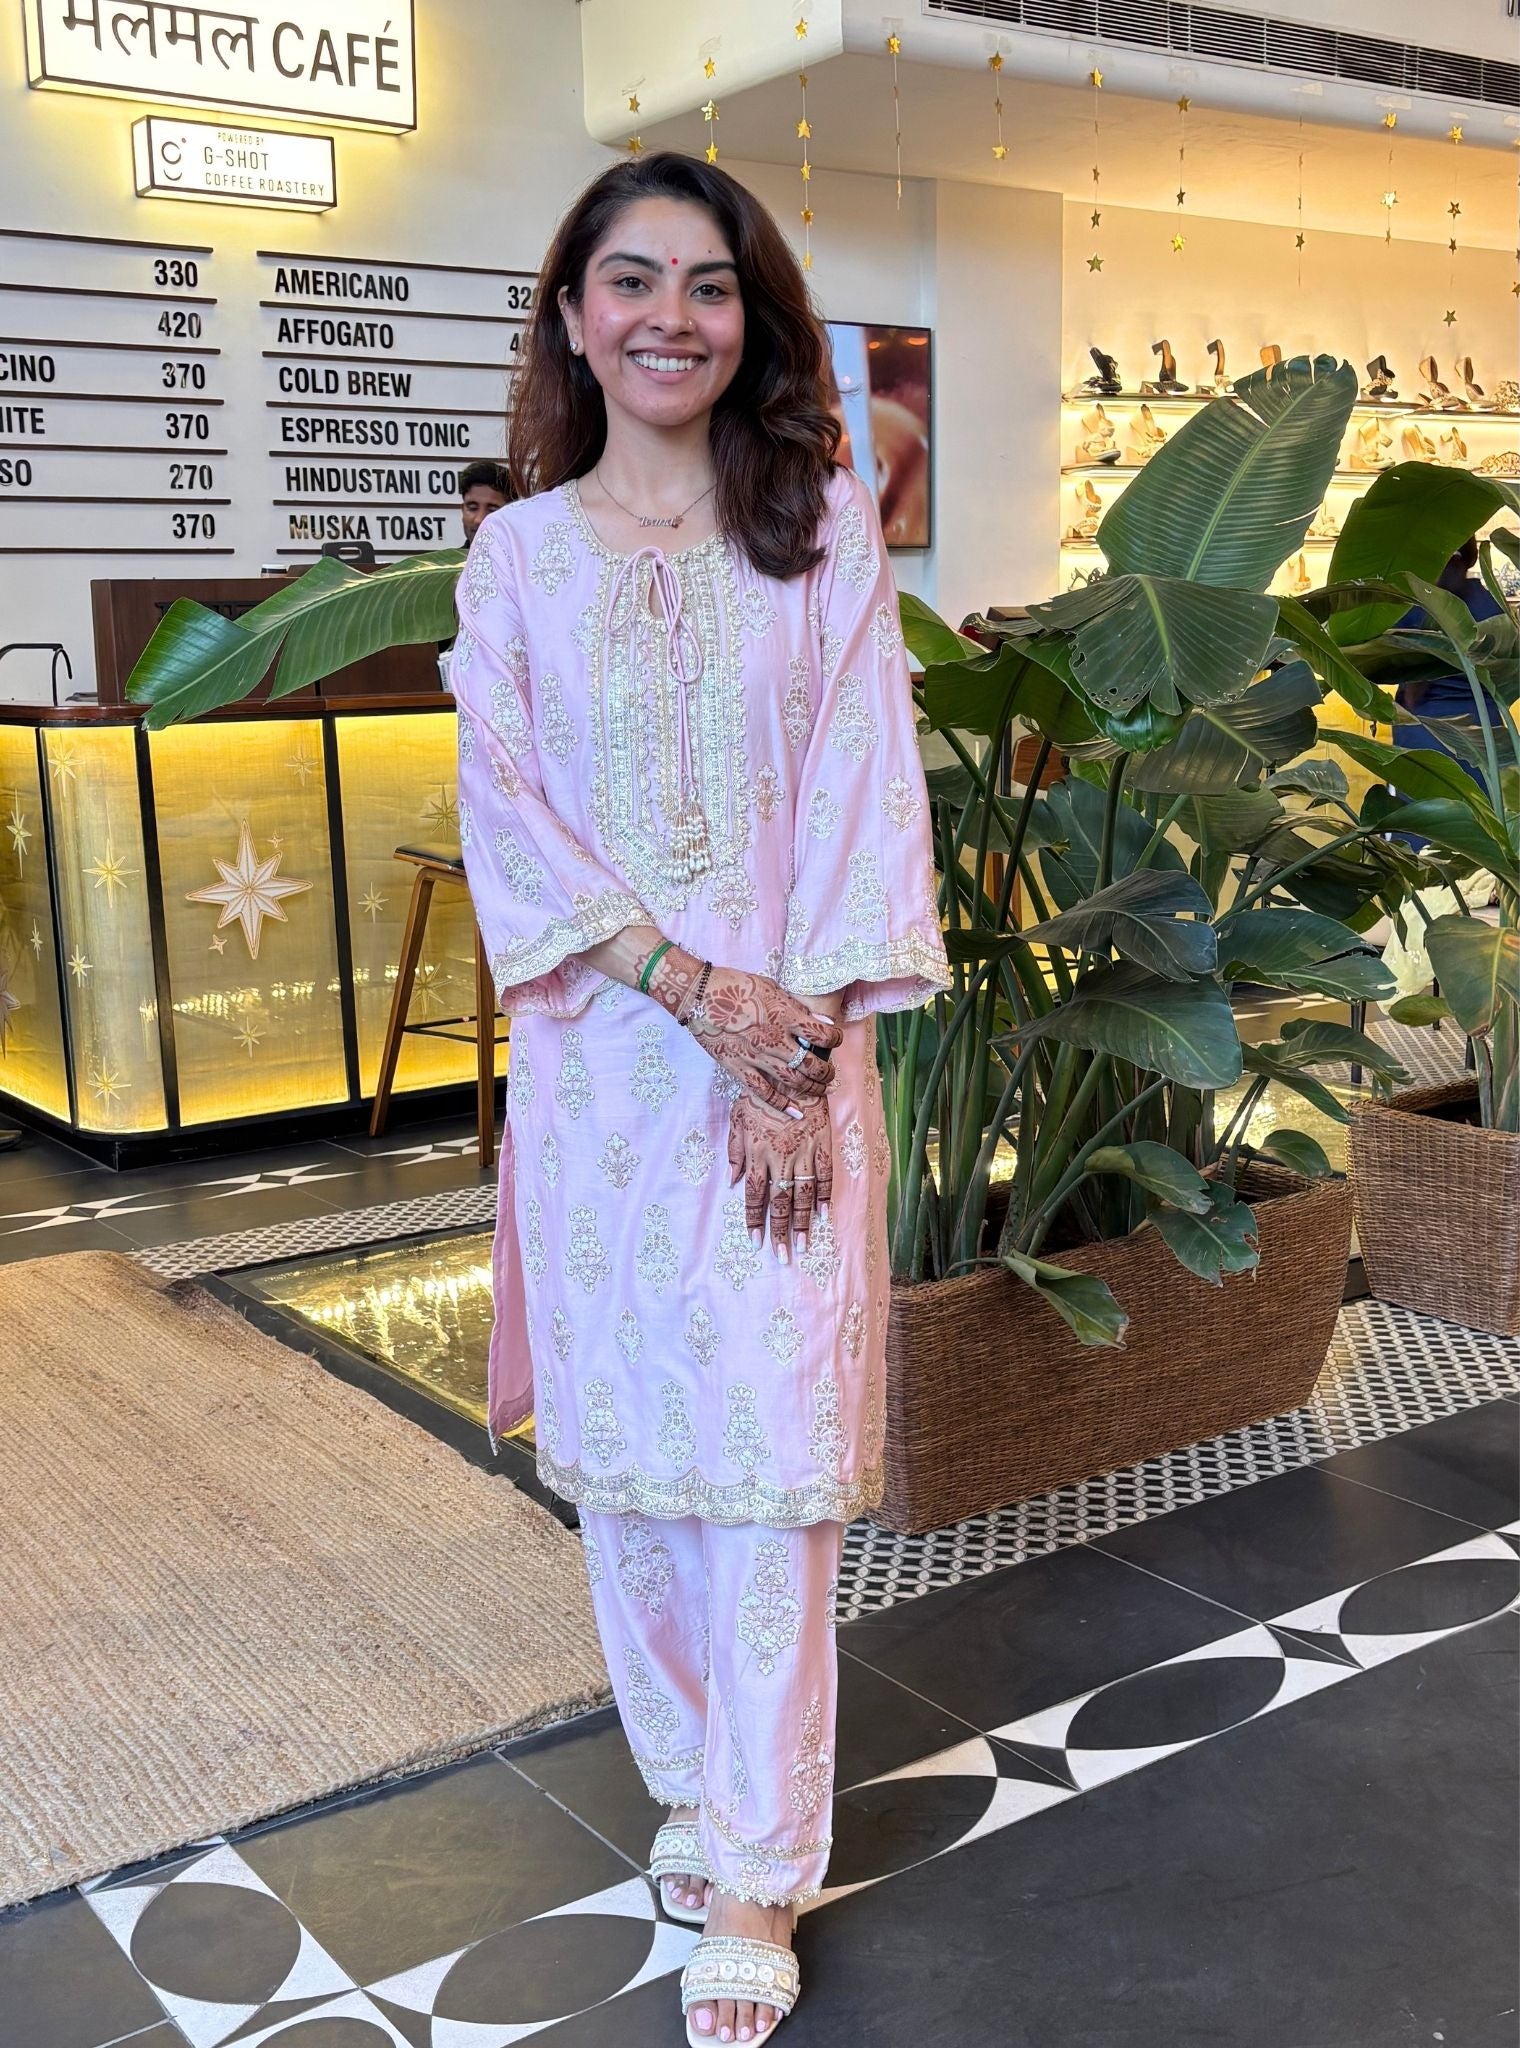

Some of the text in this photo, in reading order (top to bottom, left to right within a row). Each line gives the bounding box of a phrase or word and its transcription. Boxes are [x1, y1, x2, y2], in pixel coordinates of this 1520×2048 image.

[62, 0, 402, 93] मलमल CAFÉ
[204, 146, 269, 171] G-SHOT
[205, 172, 325, 197] COFFEE ROASTERY
[154, 259, 198, 288] 330
[275, 267, 409, 302] AMERICANO
[158, 311, 202, 339] 420
[277, 317, 394, 349] AFFOGATO
[161, 362, 206, 389] 370
[279, 366, 412, 398] COLD BREW
[166, 413, 209, 440] 370
[281, 417, 470, 448] ESPRESSO TONIC
[169, 463, 213, 490] 270
[286, 467, 421, 494] HINDUSTANI
[172, 513, 216, 539] 370
[289, 514, 446, 541] MUSKA TOAST
